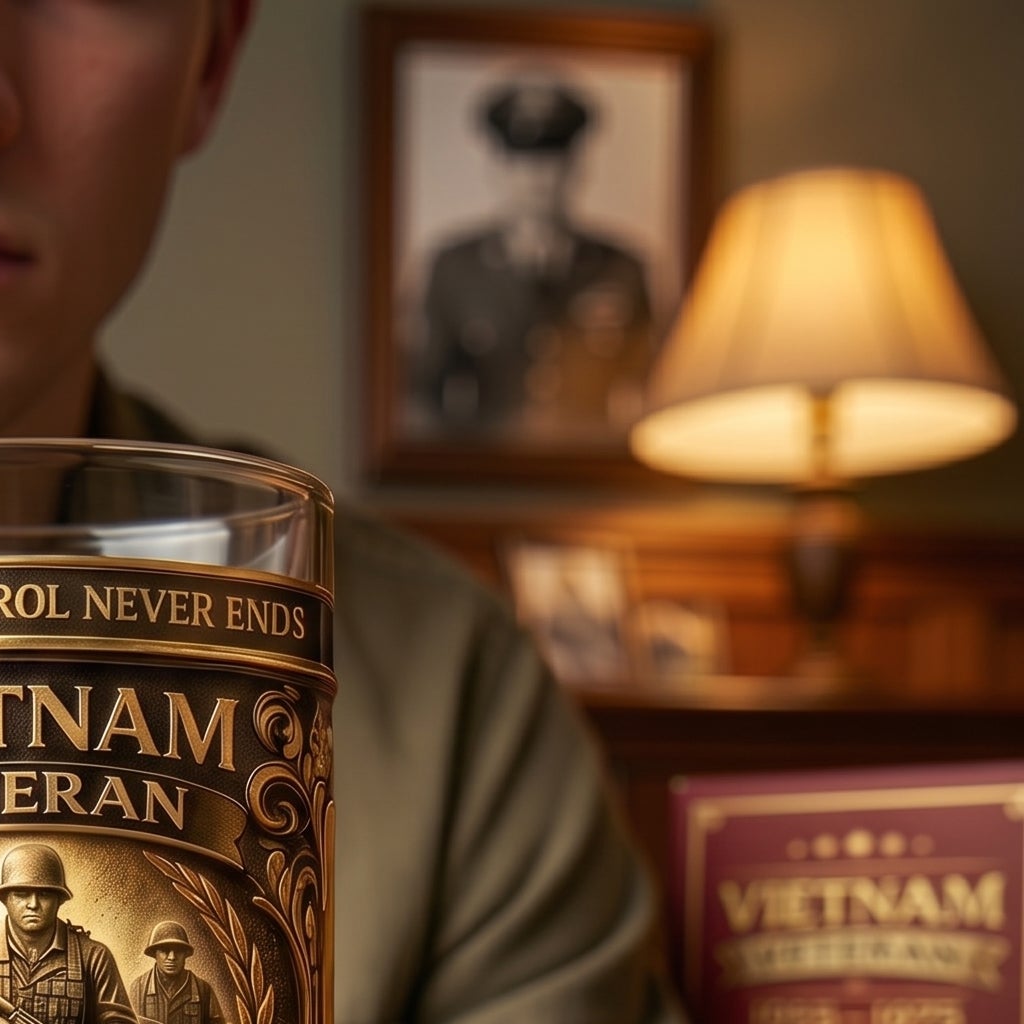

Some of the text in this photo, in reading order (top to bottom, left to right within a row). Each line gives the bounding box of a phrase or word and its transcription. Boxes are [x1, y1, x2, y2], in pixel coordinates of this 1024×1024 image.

[83, 586, 214, 627] NEVER
[225, 596, 305, 640] ENDS
[718, 870, 1006, 933] VIETNAM
